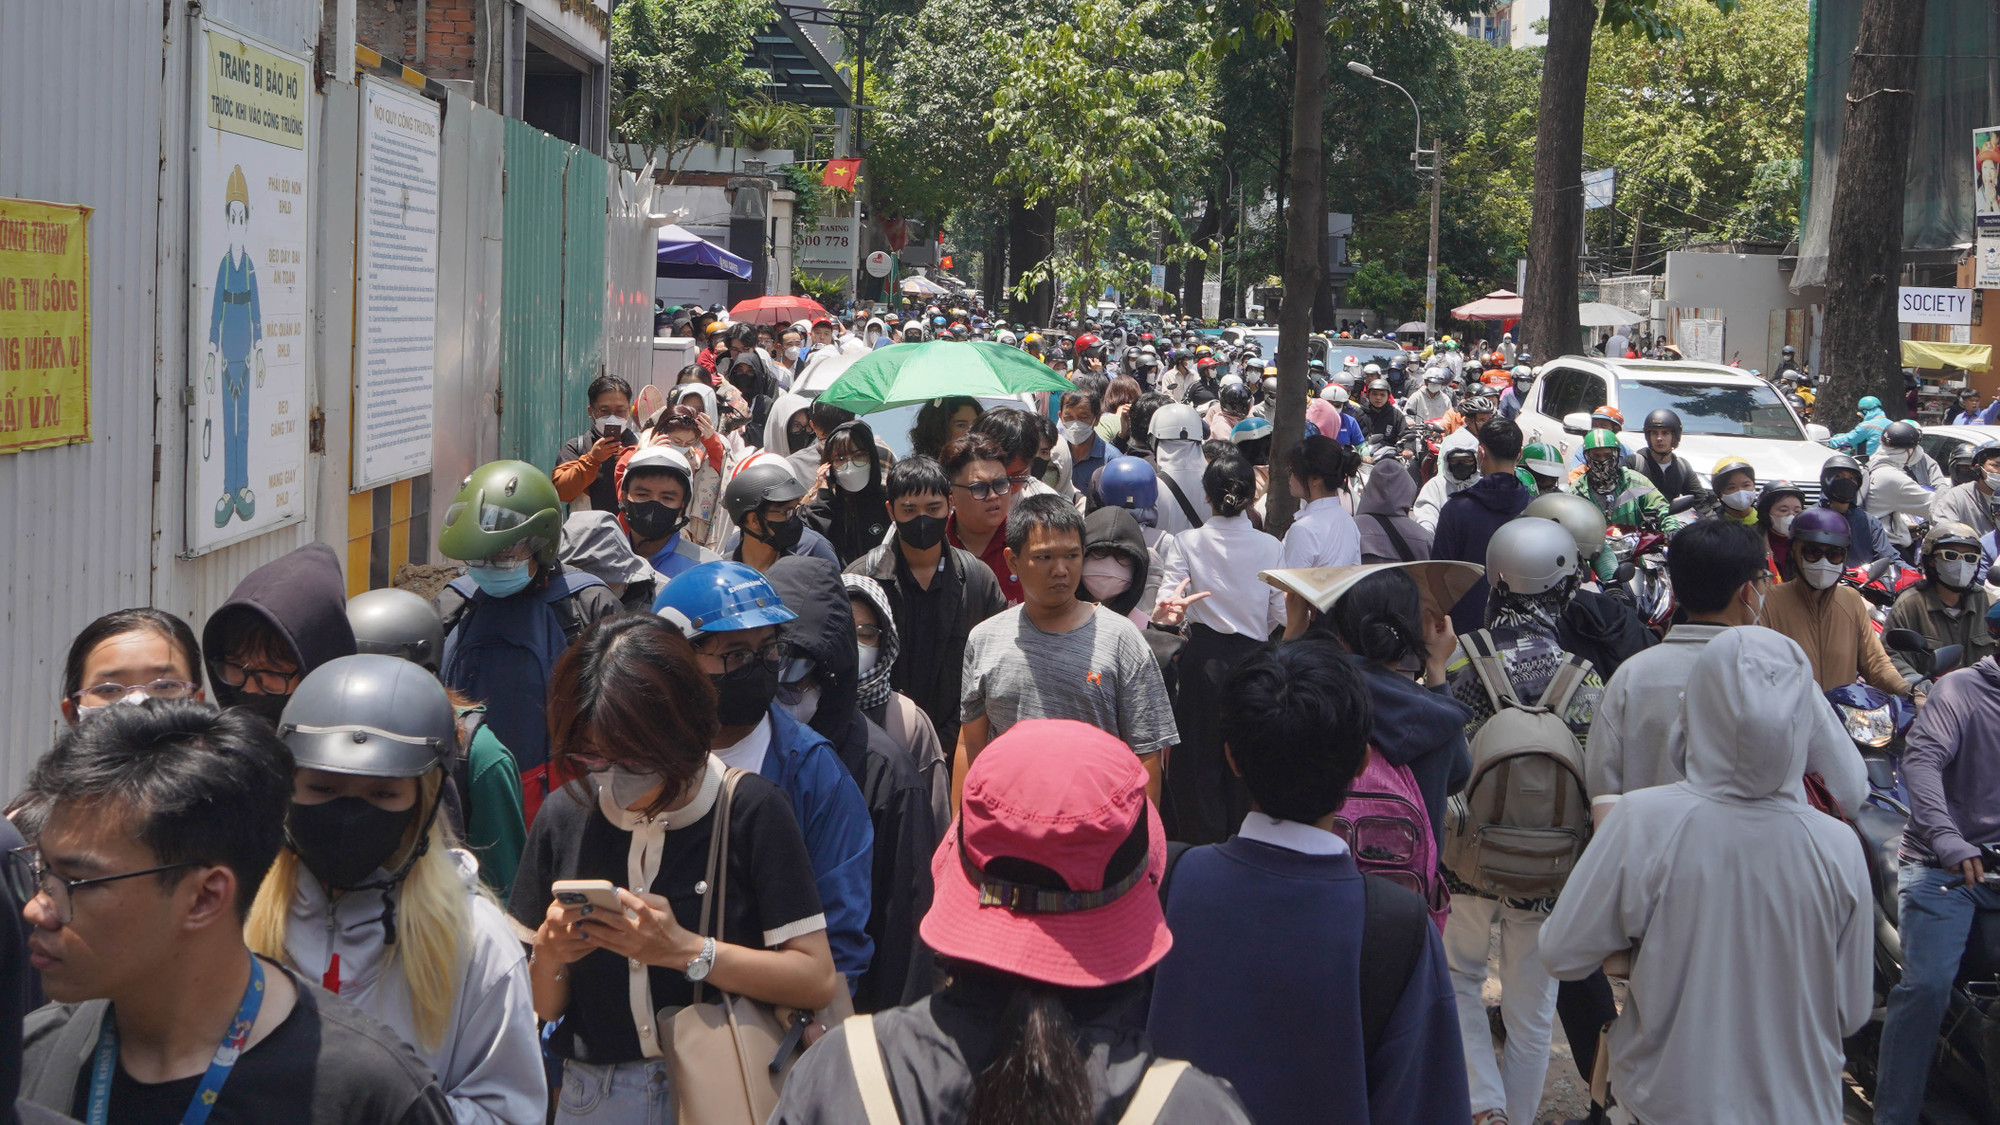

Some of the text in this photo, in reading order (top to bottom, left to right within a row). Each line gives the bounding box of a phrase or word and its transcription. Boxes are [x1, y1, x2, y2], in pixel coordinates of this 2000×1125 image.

[219, 51, 298, 107] TRANG BỊ BẢO HỘ
[211, 94, 303, 136] TRƯỚC KHI VÀO CÔNG TRƯỜNG
[819, 224, 849, 232] EASING
[825, 236, 849, 247] 778
[1903, 294, 1966, 312] SOCIETY
